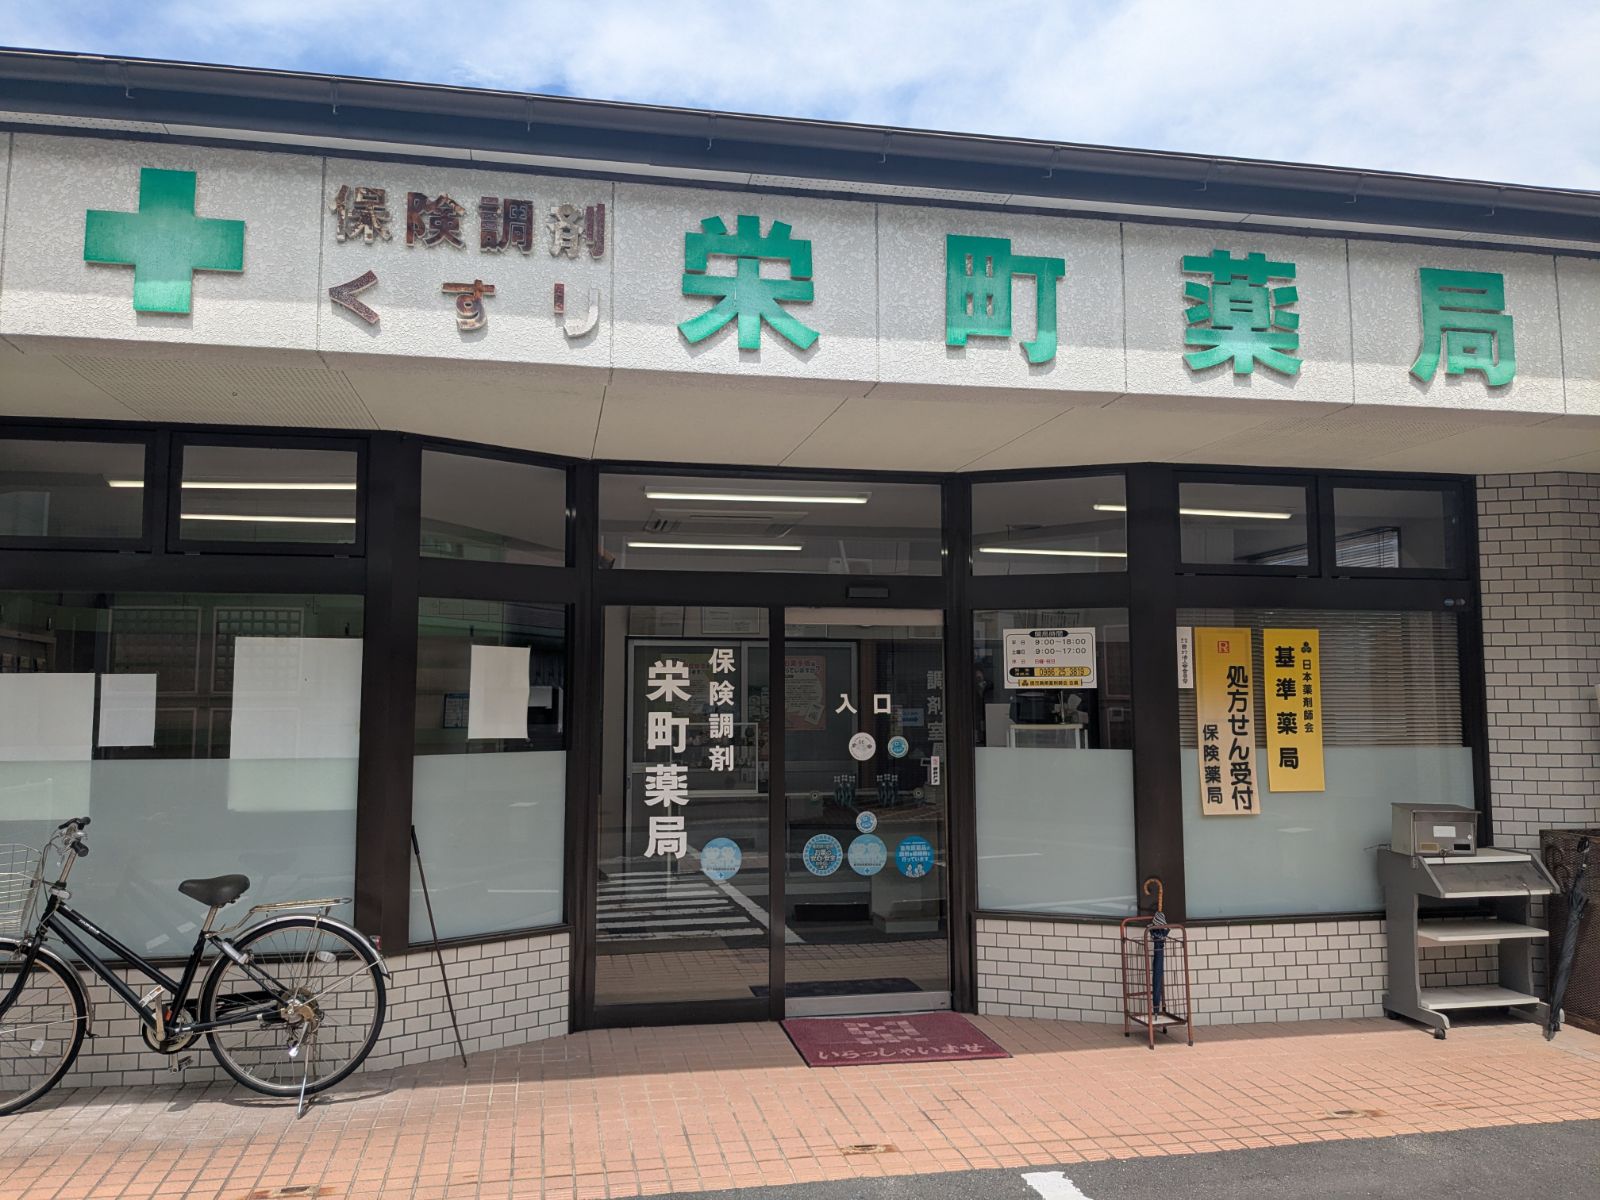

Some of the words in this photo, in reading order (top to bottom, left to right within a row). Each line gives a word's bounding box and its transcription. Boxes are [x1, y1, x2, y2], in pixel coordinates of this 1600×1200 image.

[329, 185, 606, 260] 保険調剤
[328, 269, 600, 338] くすり
[677, 214, 1517, 386] 栄町薬局
[709, 648, 736, 772] 保険調剤
[835, 693, 892, 715] 入口
[1274, 646, 1299, 770] 基準薬局
[1302, 659, 1314, 733] 日本薬剤師会
[644, 659, 692, 860] 栄町薬局
[1202, 723, 1223, 804] 保険薬局
[1226, 665, 1254, 811] 処方せん受付
[818, 1043, 986, 1060] いらっしゃいませ
